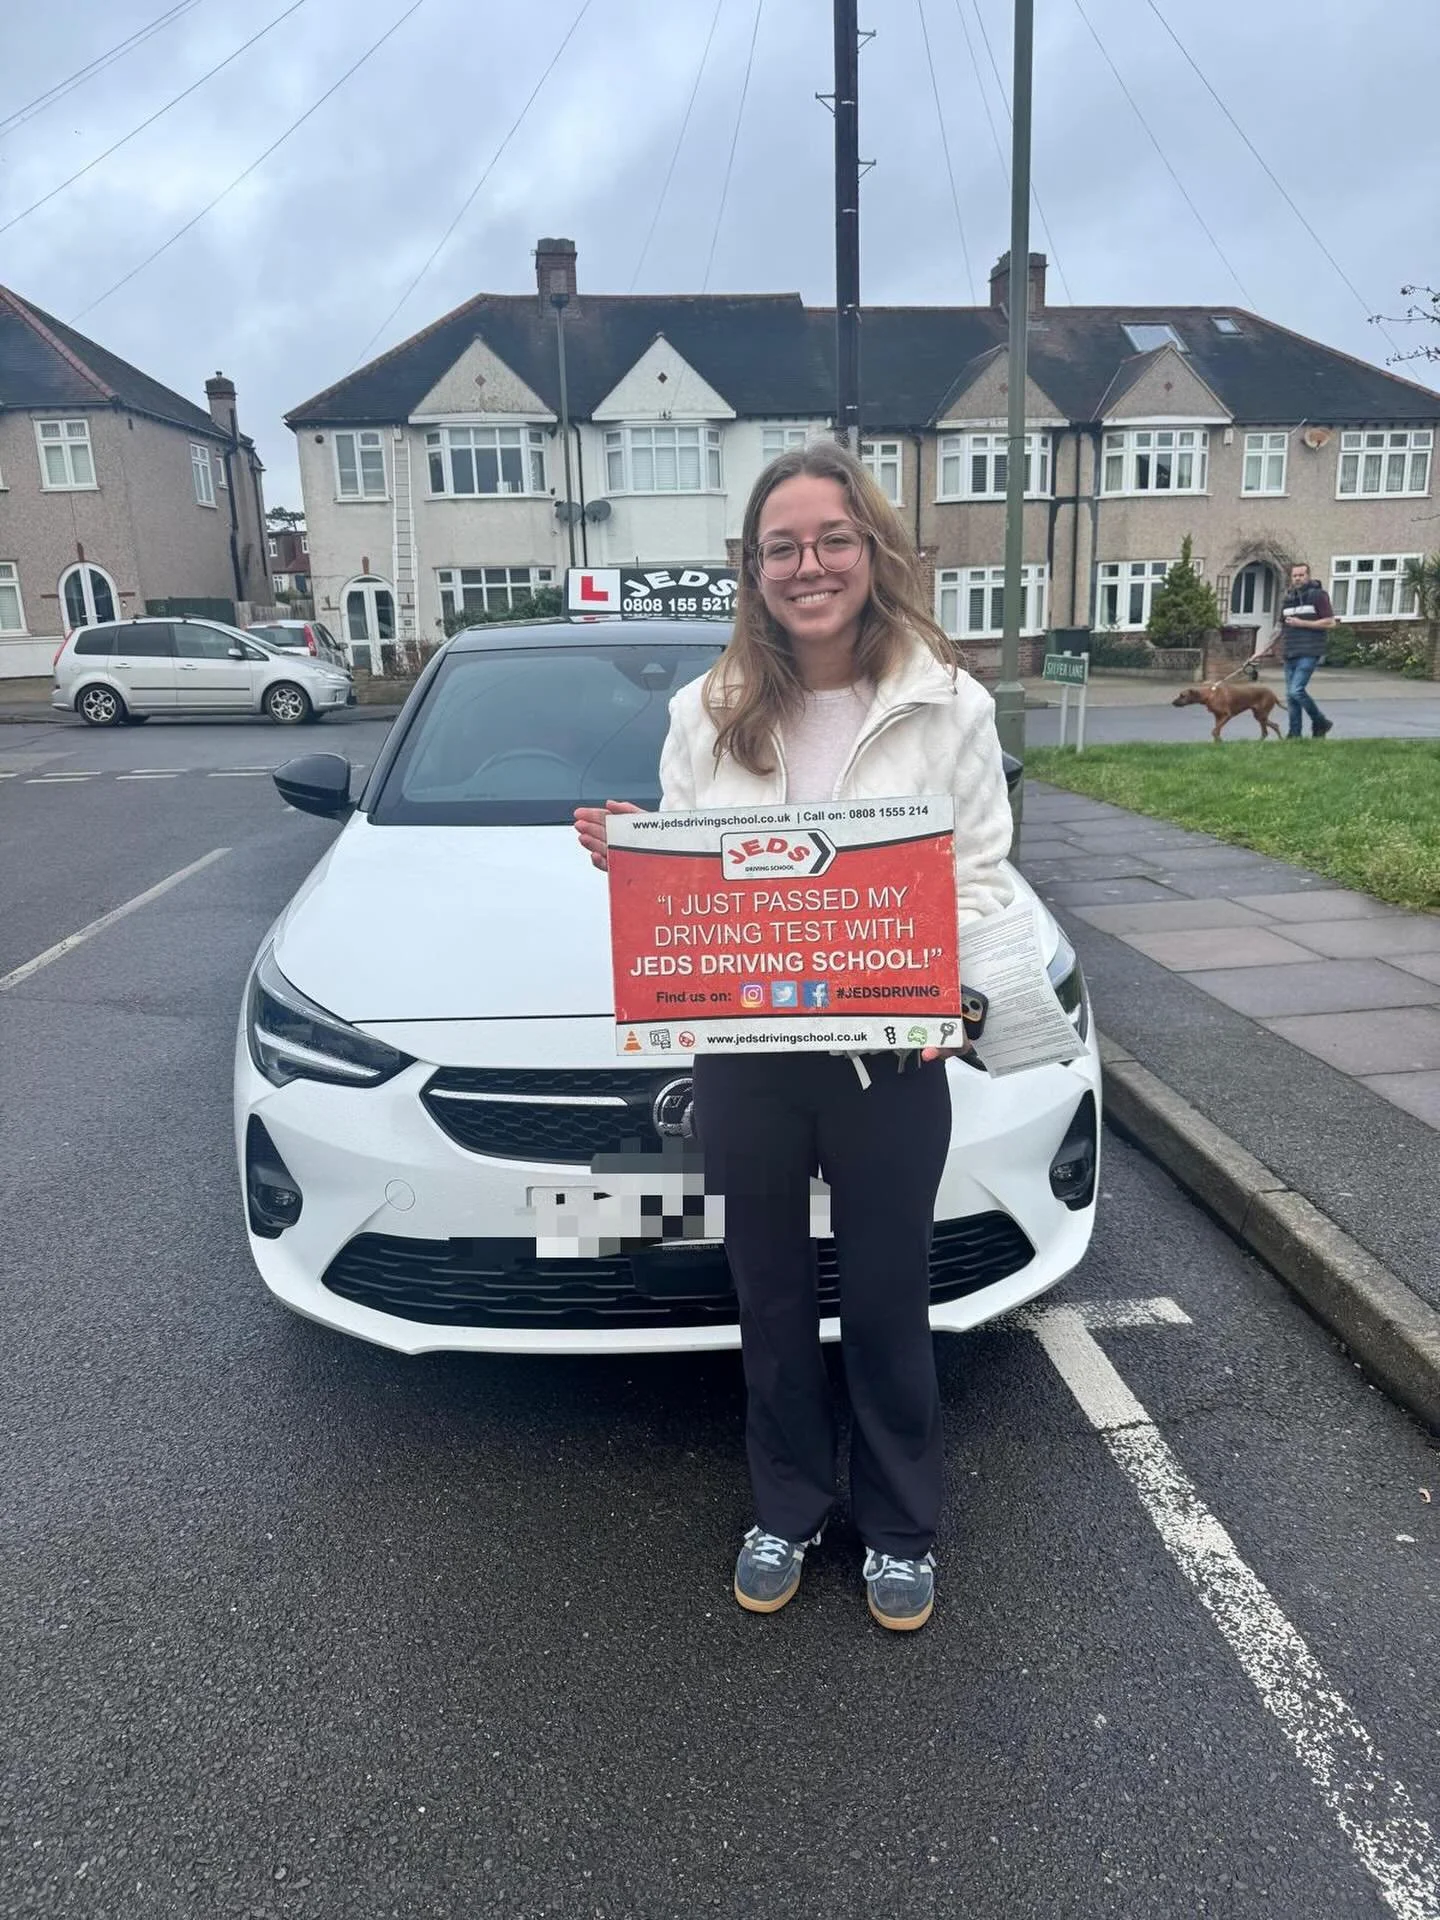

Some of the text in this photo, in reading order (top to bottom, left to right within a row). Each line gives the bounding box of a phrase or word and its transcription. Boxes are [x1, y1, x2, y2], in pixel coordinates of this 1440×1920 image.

[581, 576, 608, 601] L
[624, 570, 738, 597] JEDS
[623, 598, 663, 612] 0808
[668, 598, 697, 612] 155
[1069, 664, 1083, 679] LANE
[632, 805, 929, 830] www.jedsdrivingschool.co.uk Call on: 0808 1555 214
[728, 838, 811, 865] JEDS
[681, 893, 745, 916] JUST
[754, 889, 860, 913] PASSED
[869, 886, 908, 909] MY
[655, 918, 914, 947] DRIVING TEST WITH
[630, 955, 693, 977] JEDS
[701, 952, 804, 975] DRIVING
[656, 991, 687, 1004] Find
[688, 993, 706, 1003] us
[708, 991, 732, 1003] on:
[836, 985, 940, 999] #JEDSDRIVING
[707, 1031, 867, 1046] www.jedsdrivingschool.co.uk
